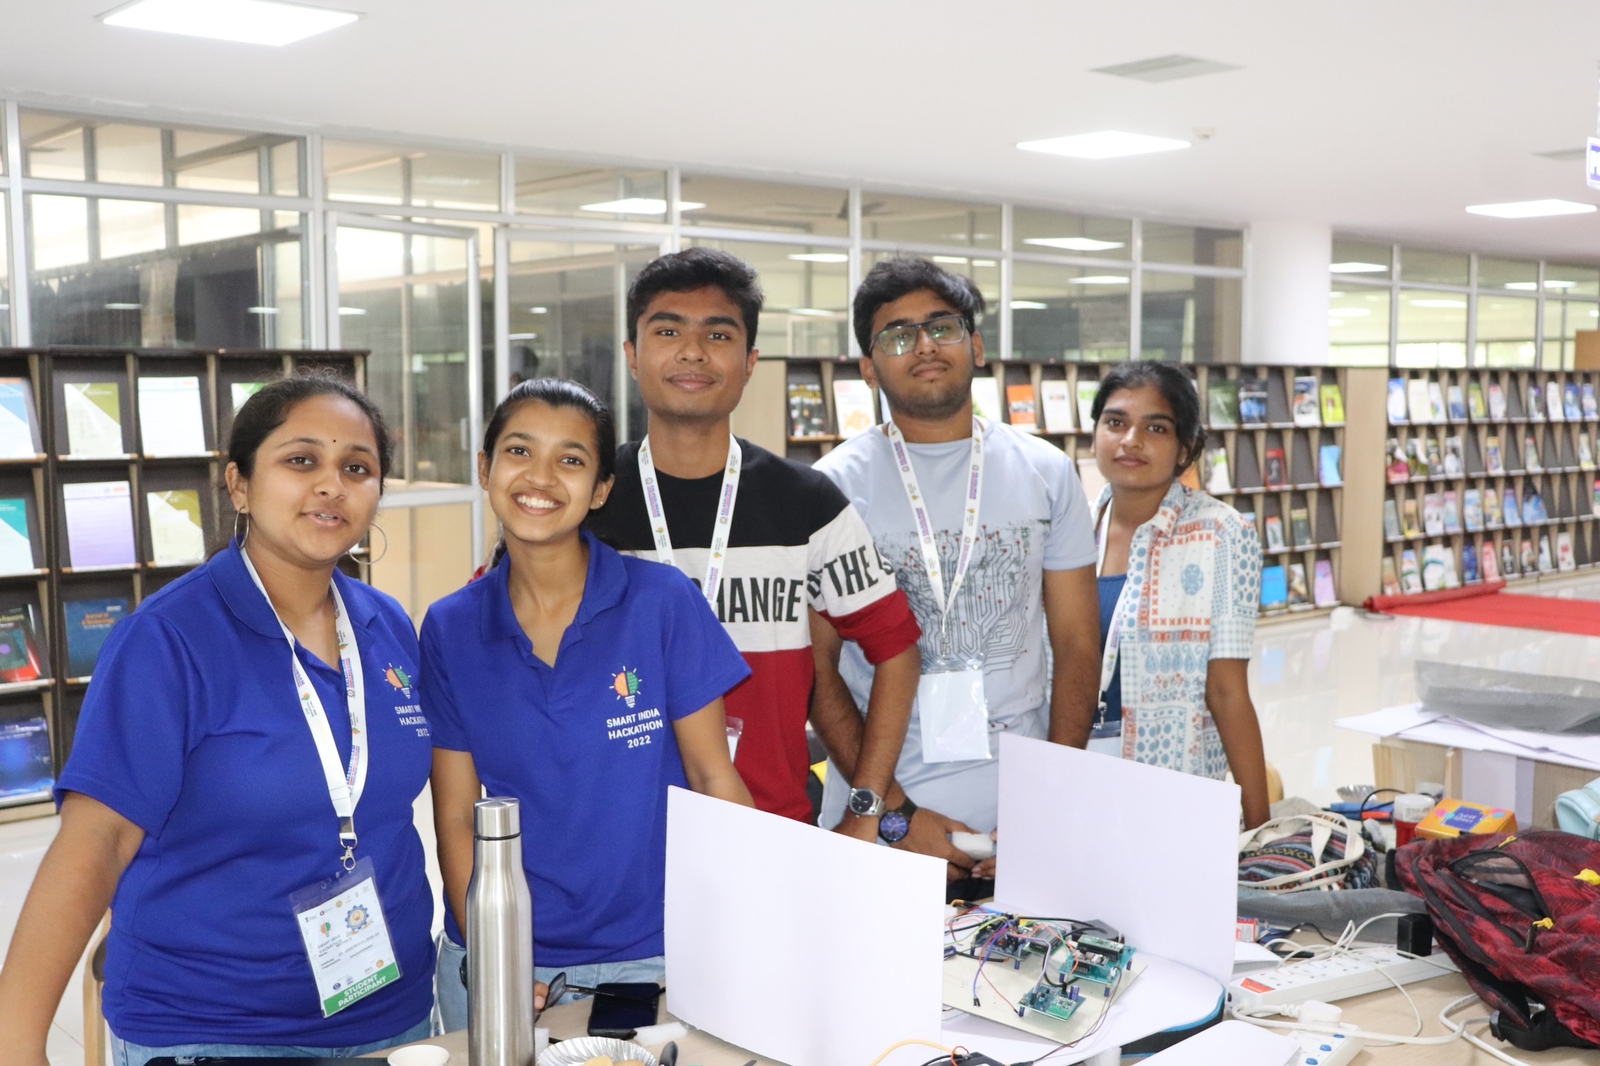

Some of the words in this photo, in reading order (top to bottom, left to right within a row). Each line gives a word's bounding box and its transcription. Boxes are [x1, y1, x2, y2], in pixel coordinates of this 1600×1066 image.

[823, 545, 879, 597] THE
[606, 713, 637, 728] SMART
[637, 707, 661, 721] INDIA
[608, 719, 663, 740] HACKATHON
[627, 734, 652, 749] 2022
[338, 975, 386, 1007] PARTICIPANT
[343, 973, 378, 997] STUDENT
